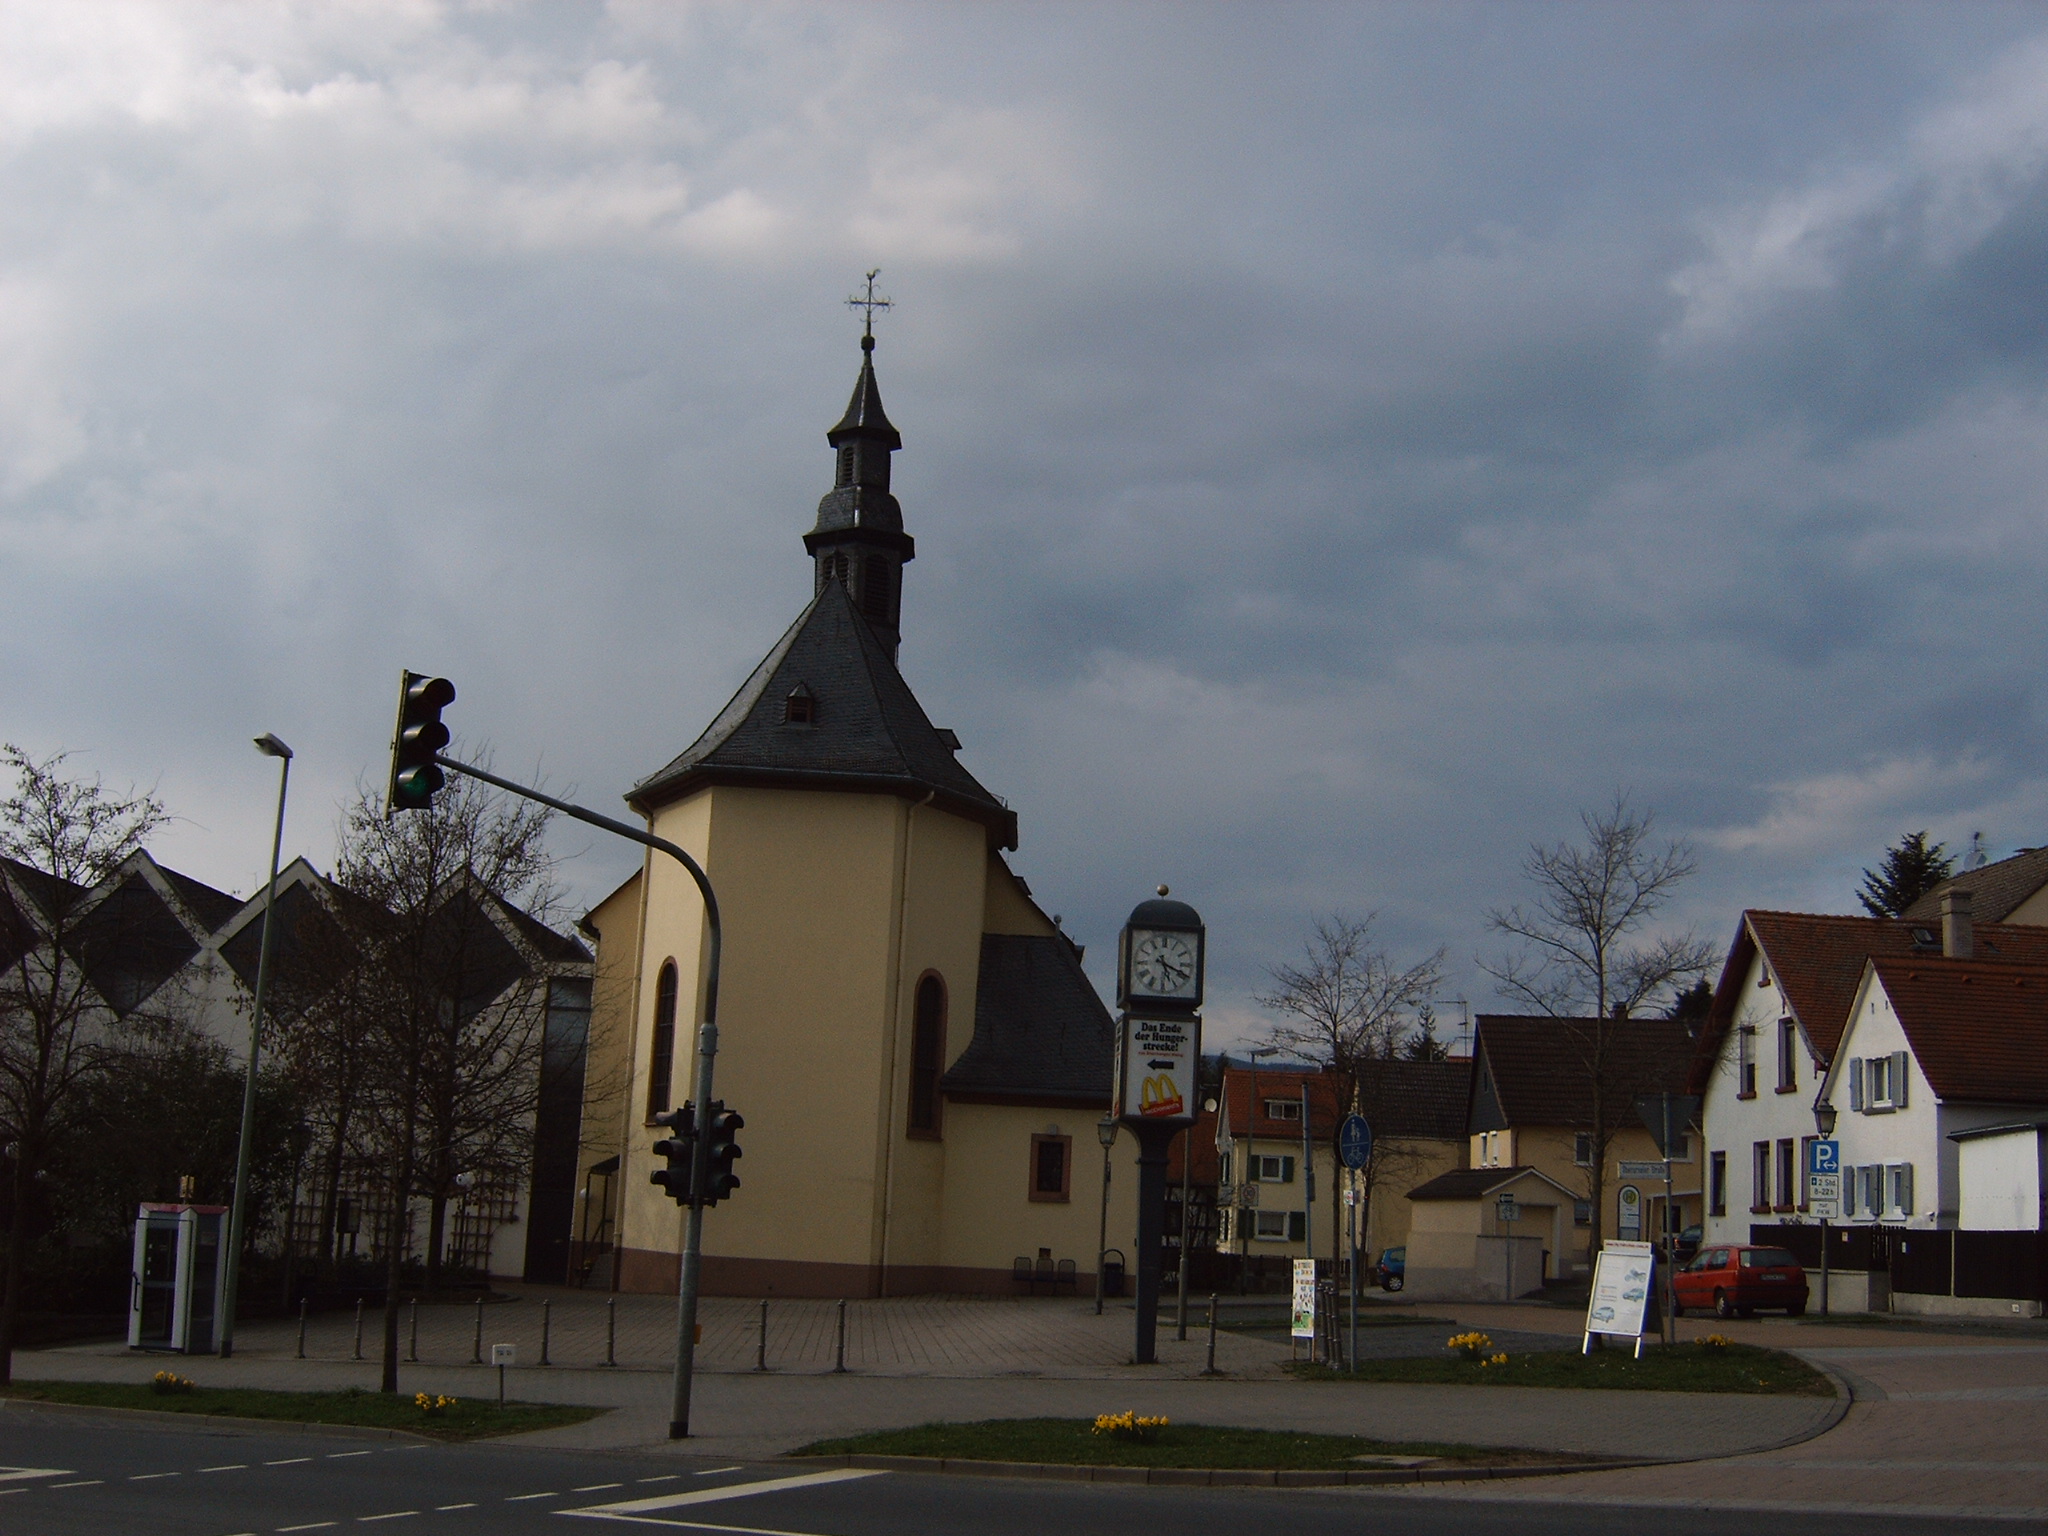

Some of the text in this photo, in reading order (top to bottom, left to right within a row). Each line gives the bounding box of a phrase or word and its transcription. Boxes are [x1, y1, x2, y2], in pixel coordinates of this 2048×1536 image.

[1141, 1022, 1182, 1033] Das Ende
[1134, 1031, 1150, 1041] der
[1152, 1032, 1188, 1044] Hunger-
[1143, 1042, 1178, 1052] strecke!
[1816, 1144, 1832, 1169] P
